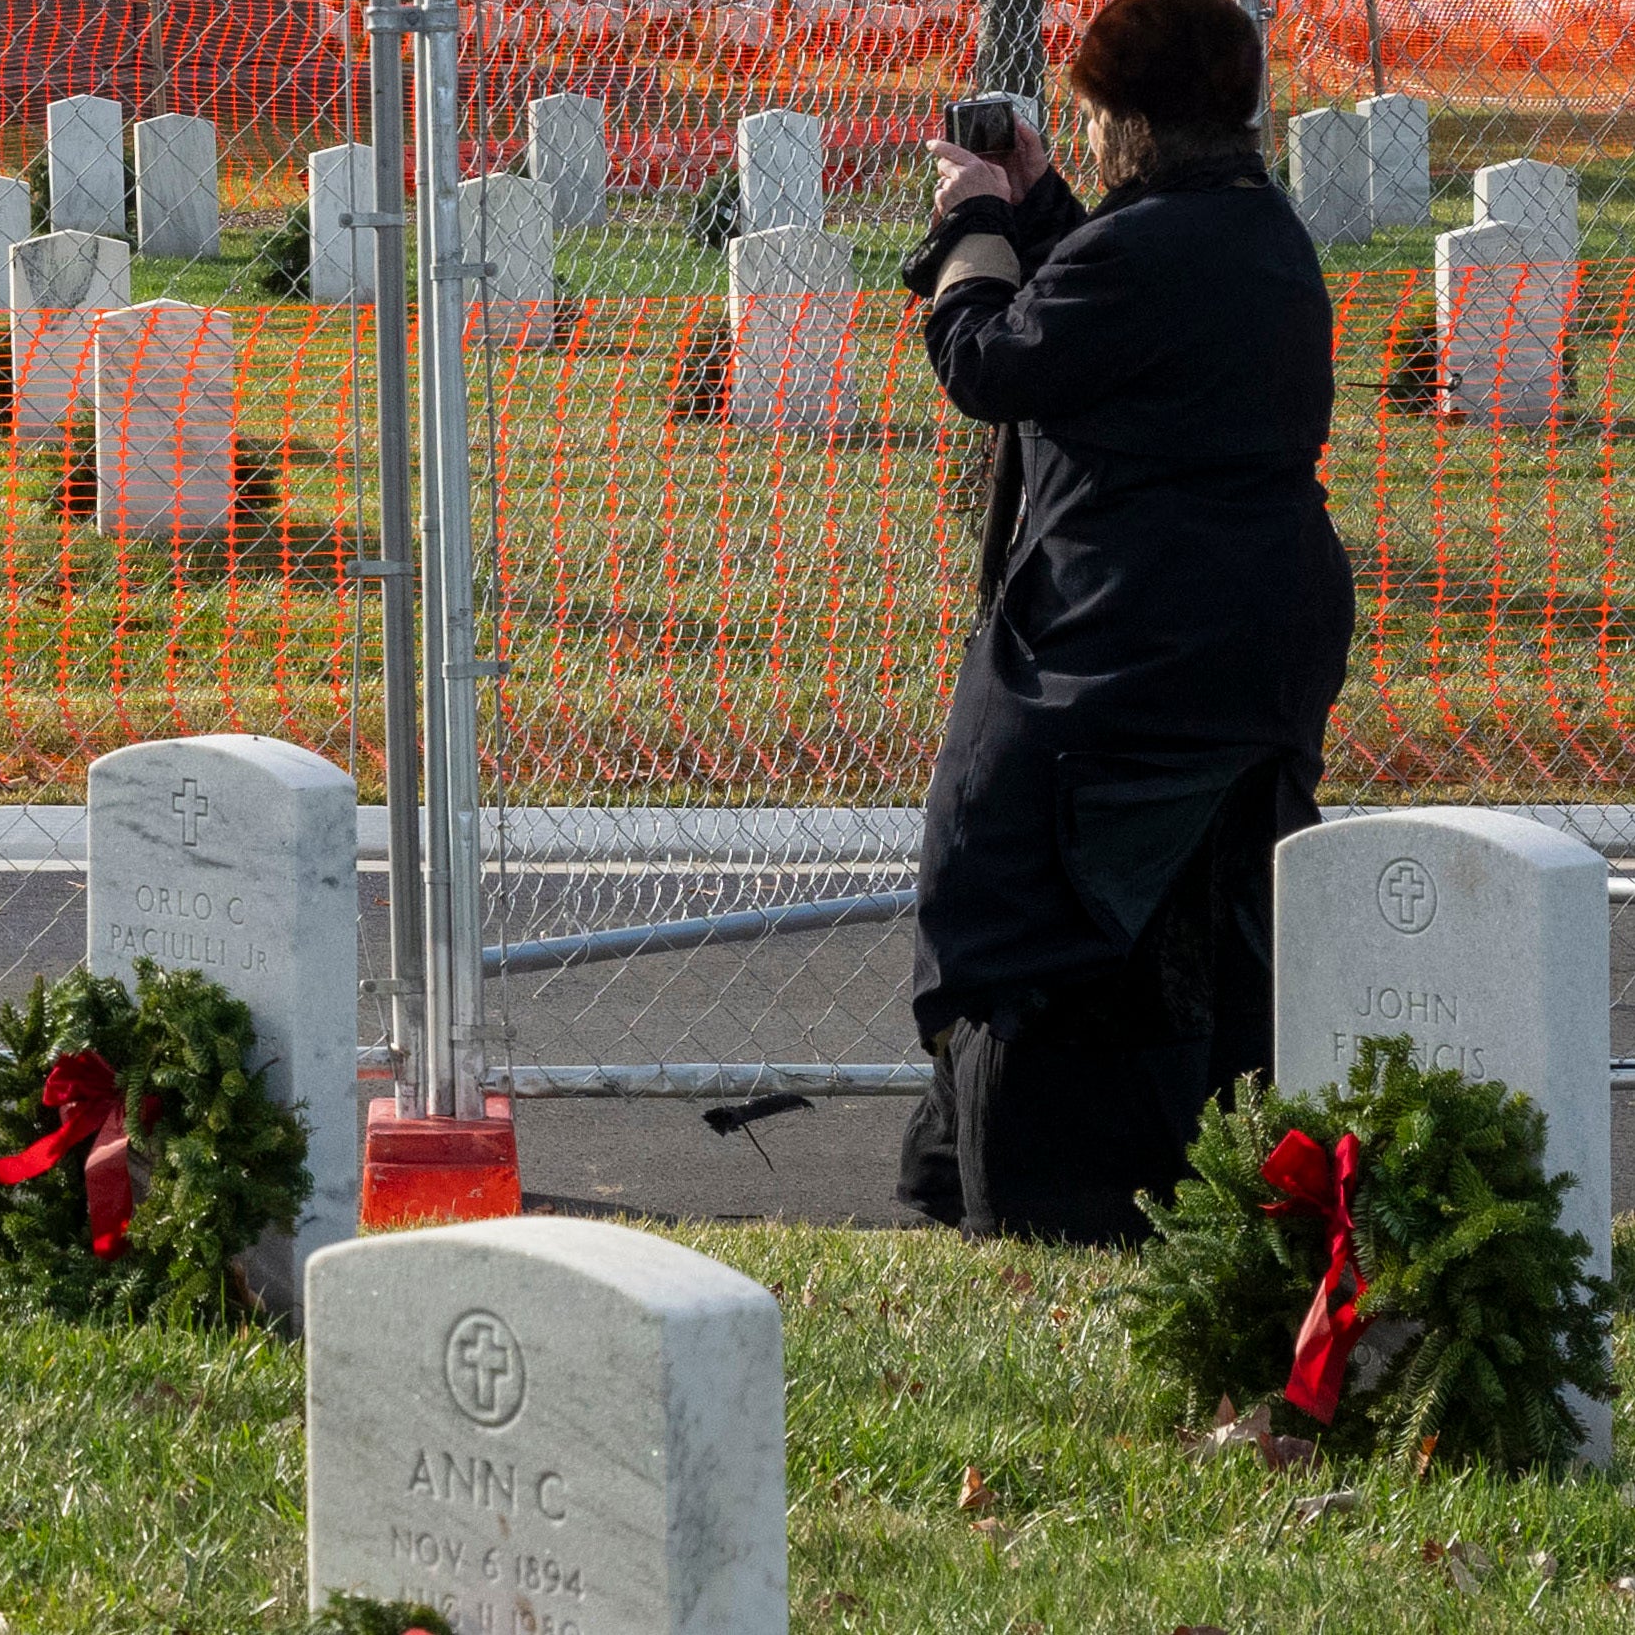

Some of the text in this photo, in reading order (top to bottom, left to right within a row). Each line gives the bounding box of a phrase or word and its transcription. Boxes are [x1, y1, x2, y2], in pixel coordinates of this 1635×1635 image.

[136, 884, 245, 926] ORLO C
[110, 923, 226, 966] PACIULLI
[1356, 986, 1458, 1025] JOHN
[408, 1450, 567, 1521] ANN C
[390, 1524, 583, 1600] NOV 6 1894
